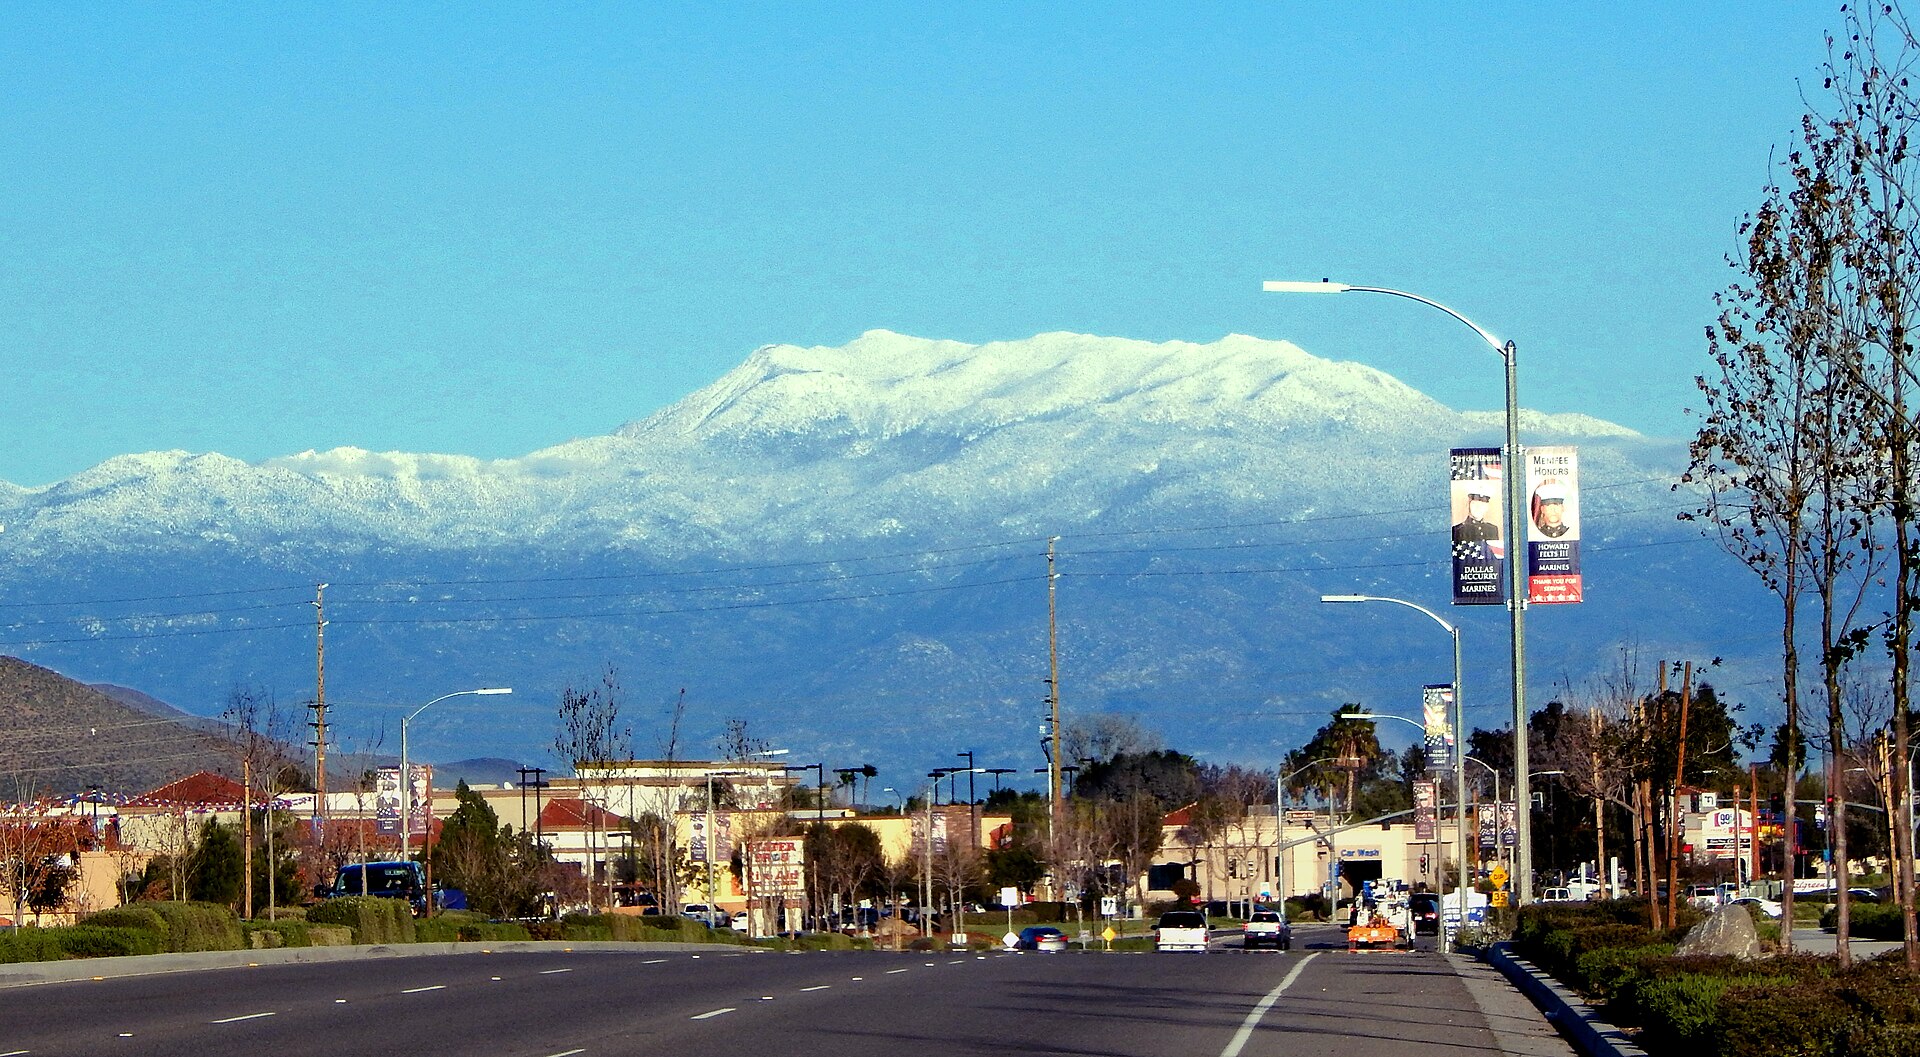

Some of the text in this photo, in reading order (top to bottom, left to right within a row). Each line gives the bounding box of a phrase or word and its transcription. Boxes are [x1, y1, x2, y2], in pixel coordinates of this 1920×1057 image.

[1533, 456, 1569, 464] MENIFEE
[1535, 467, 1569, 475] HONORS
[1341, 849, 1379, 857] Car Wash
[1494, 893, 1506, 901] 35
